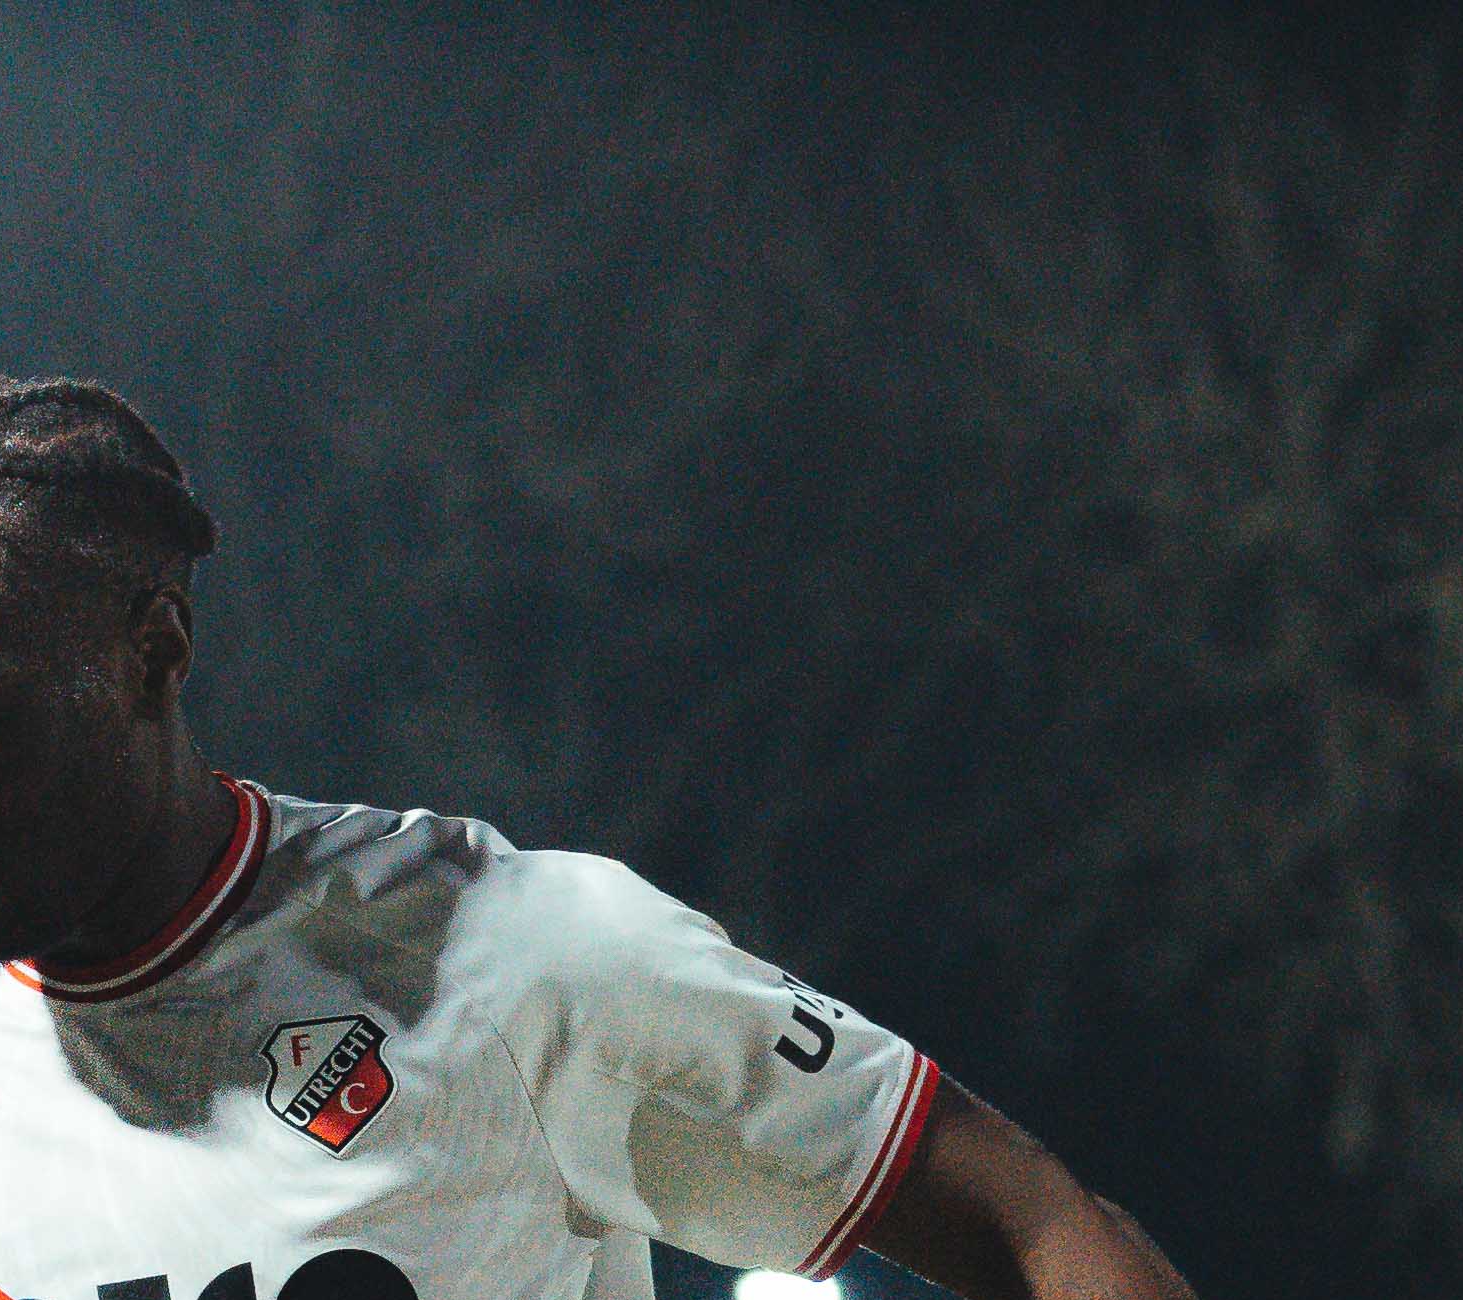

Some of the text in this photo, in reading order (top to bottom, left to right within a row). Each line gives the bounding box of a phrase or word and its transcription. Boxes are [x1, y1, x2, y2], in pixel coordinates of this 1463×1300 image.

[291, 1034, 310, 1066] F
[284, 1023, 374, 1127] UTRECHT
[340, 1083, 368, 1115] C
